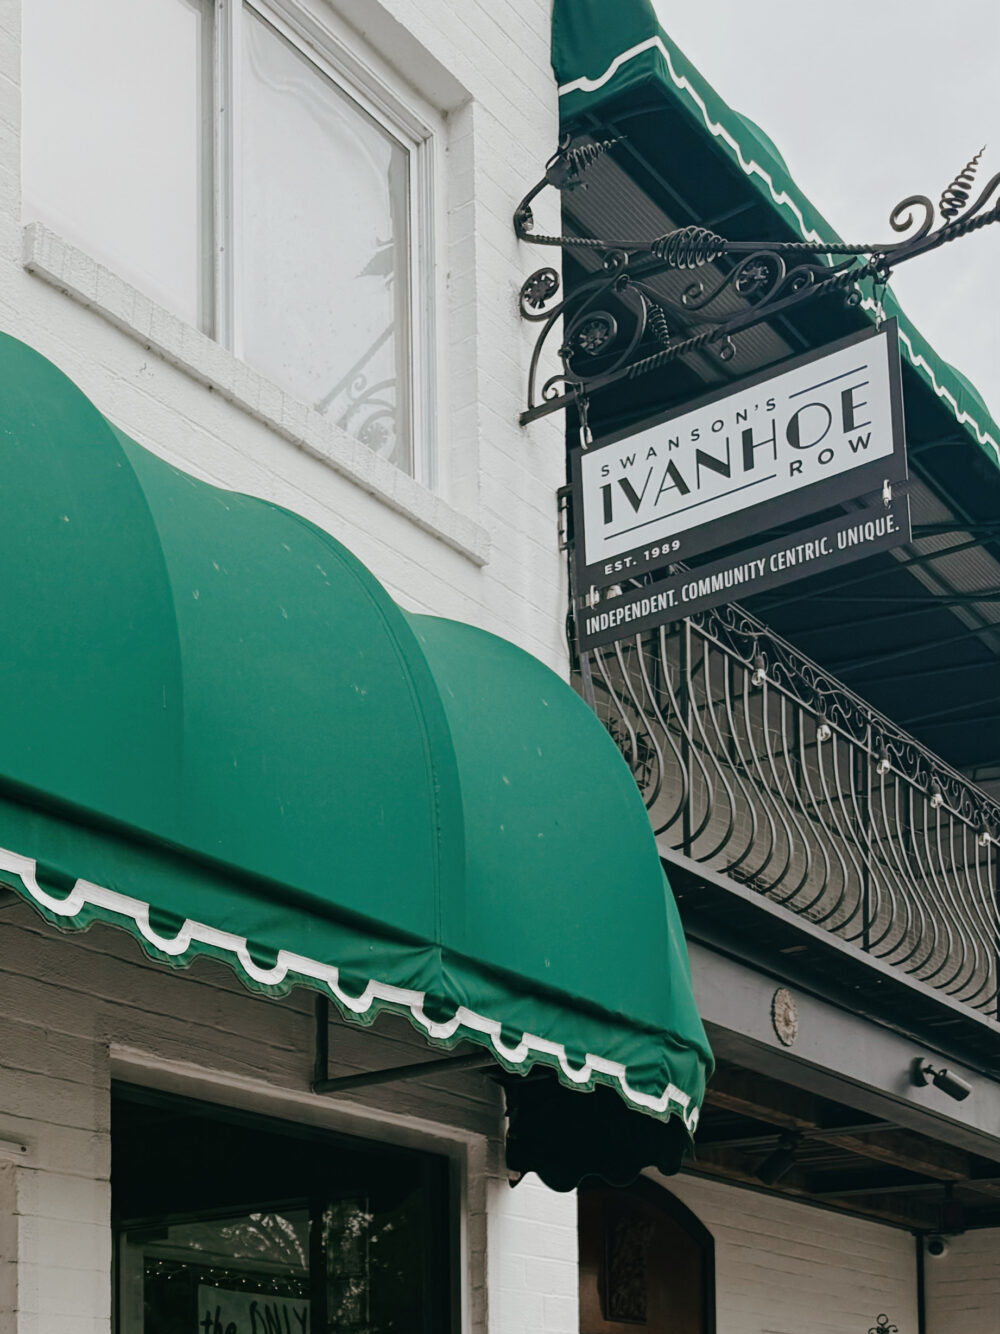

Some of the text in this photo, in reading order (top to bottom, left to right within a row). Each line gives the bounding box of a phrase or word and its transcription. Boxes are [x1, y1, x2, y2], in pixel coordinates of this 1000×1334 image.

[600, 380, 872, 525] IVANHOE
[601, 397, 776, 477] SWANSON'S
[789, 432, 872, 477] ROW
[585, 514, 900, 635] INDEPENDENT. COMMUNITY CENTRIC. UNIQUE.
[604, 539, 681, 575] EST. 1989
